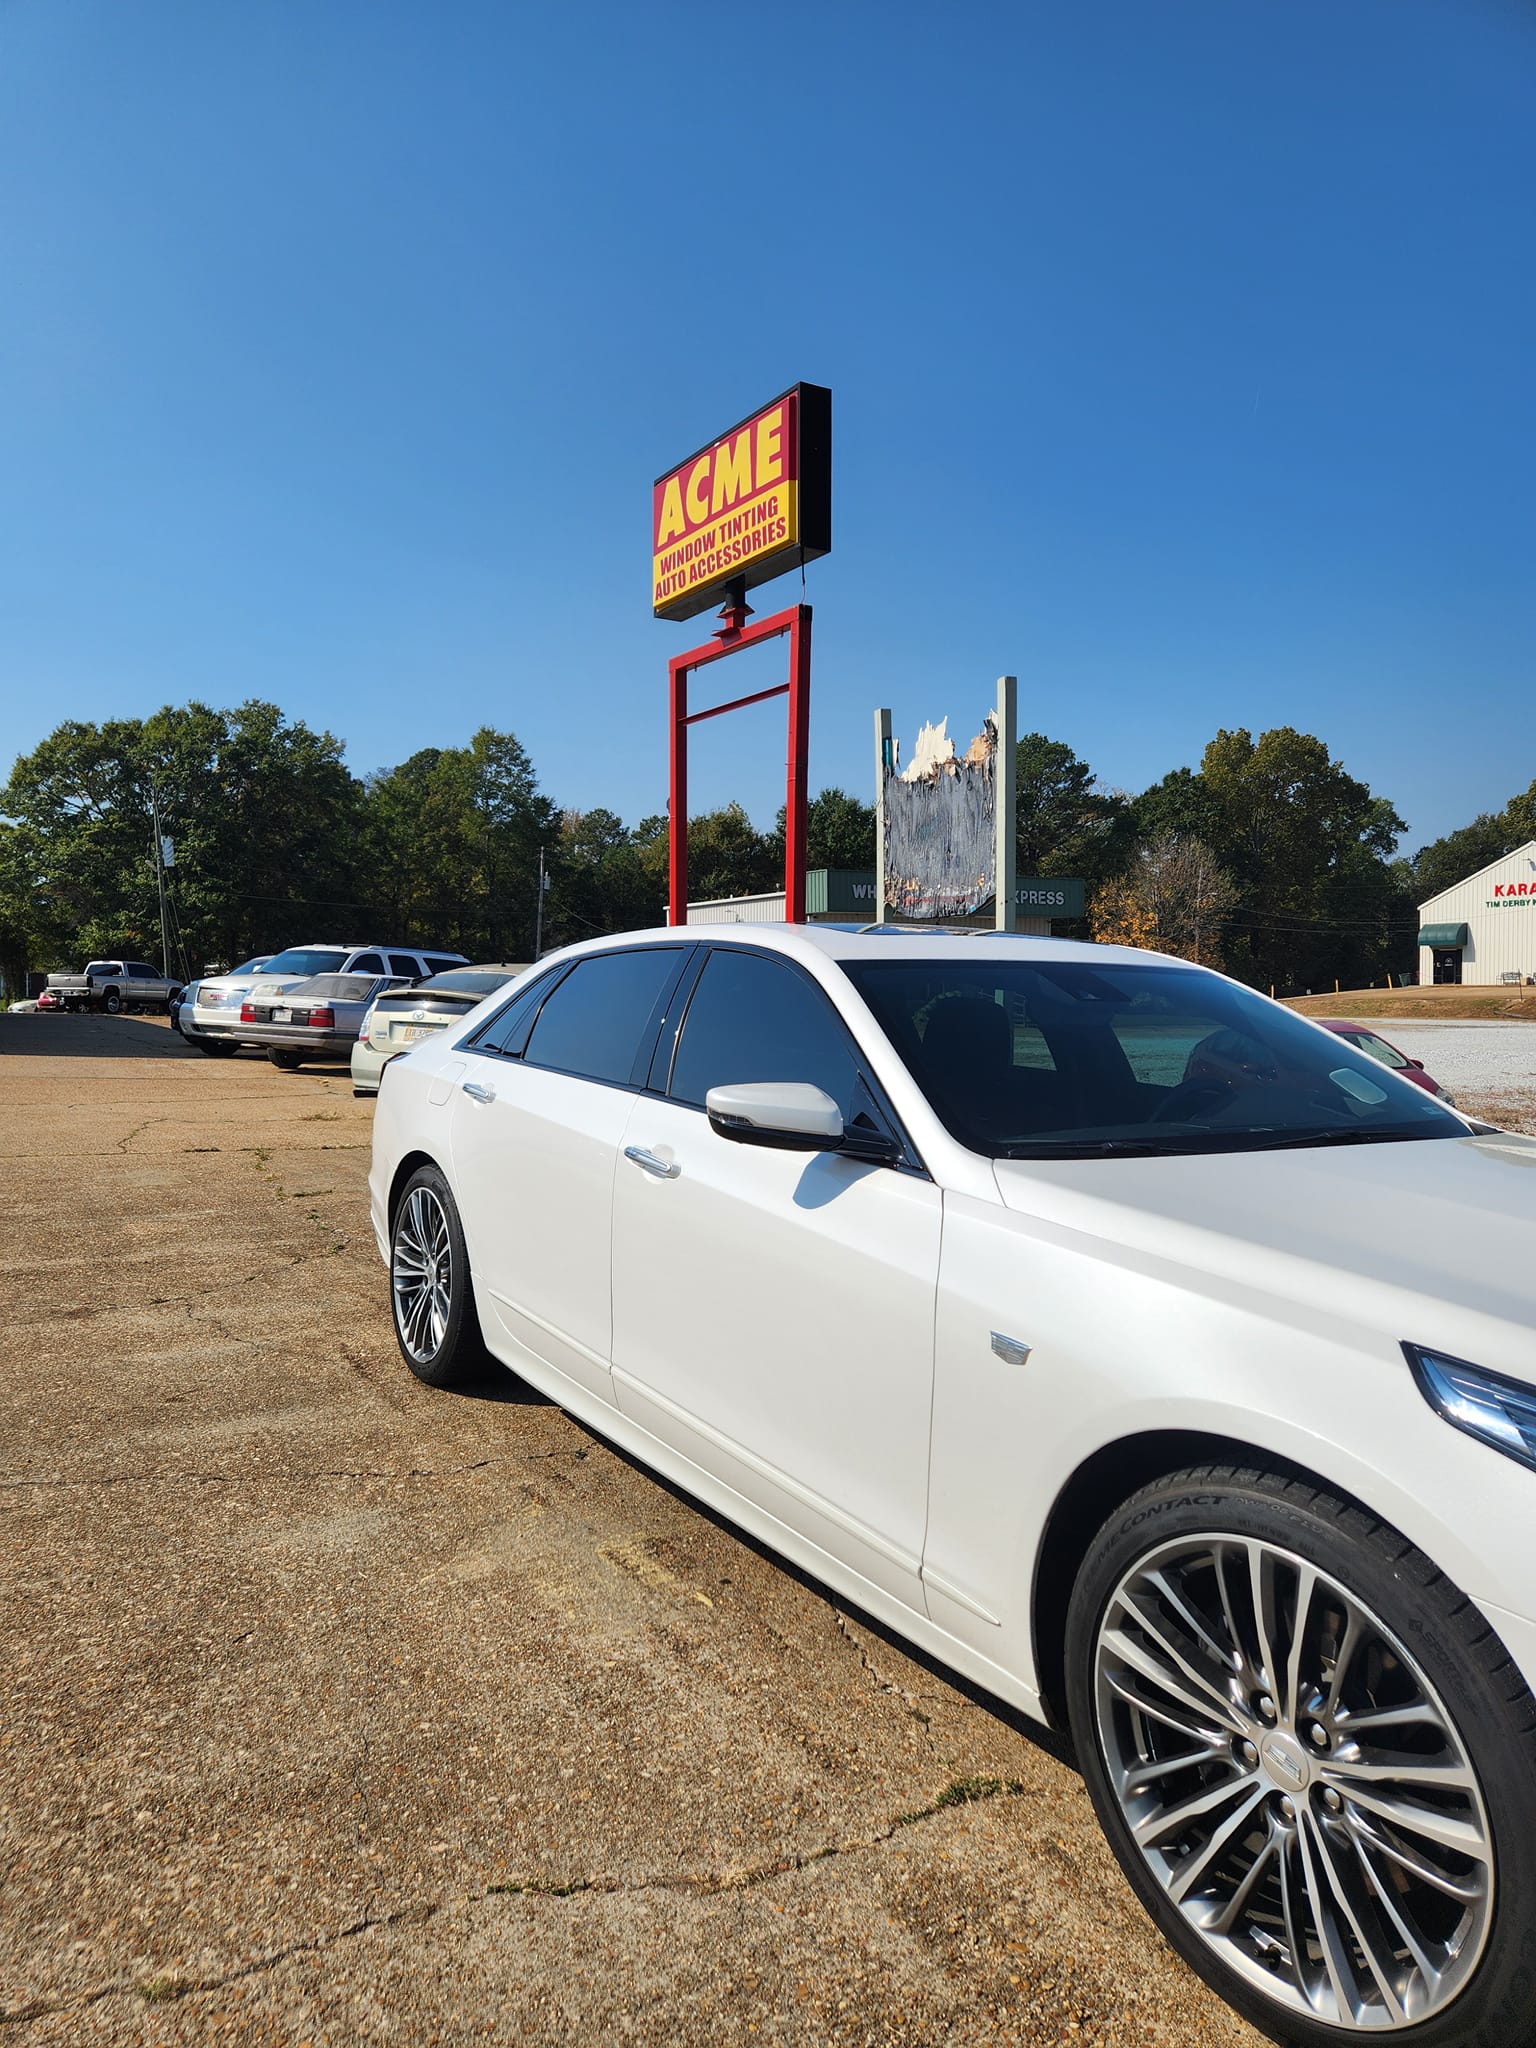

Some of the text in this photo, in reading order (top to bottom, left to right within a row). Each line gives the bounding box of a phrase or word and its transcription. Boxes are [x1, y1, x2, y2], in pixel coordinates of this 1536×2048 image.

[657, 407, 782, 548] ACME
[655, 516, 786, 600] AUTO ACCESSORIES
[660, 495, 778, 576] WINDOW TINTING
[1495, 883, 1536, 897] KARA
[1502, 899, 1531, 908] DERBY
